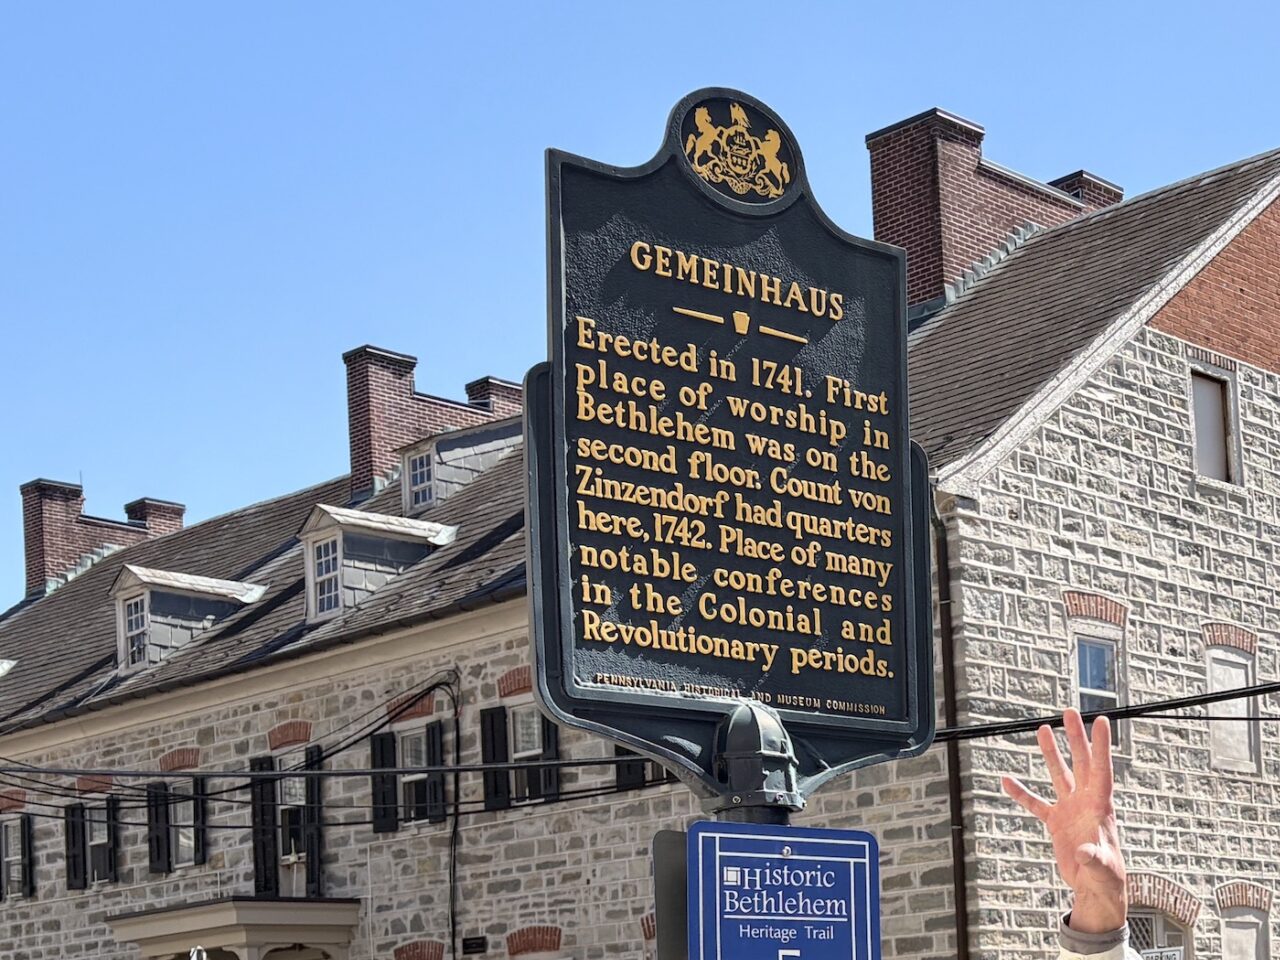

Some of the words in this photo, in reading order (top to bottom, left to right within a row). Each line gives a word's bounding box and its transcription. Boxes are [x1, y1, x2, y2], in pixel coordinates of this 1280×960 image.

[630, 241, 844, 321] GEMEINHAUS
[576, 316, 698, 373] Erected
[709, 350, 737, 382] in
[752, 357, 812, 399] 1741.
[825, 375, 890, 416] First
[575, 359, 666, 401] place
[679, 382, 713, 411] of
[726, 395, 847, 447] worship
[863, 419, 890, 450] in
[576, 391, 736, 450] Bethlehem
[745, 433, 796, 463] was
[806, 447, 838, 473] on
[849, 451, 891, 483] the
[575, 465, 730, 519] Zinzendorf
[735, 493, 782, 528] had
[786, 510, 893, 548] quarters
[577, 437, 678, 474] second
[688, 452, 762, 491] floor.
[770, 467, 843, 506] Count
[848, 489, 892, 515] von
[578, 501, 649, 543] here,
[652, 513, 713, 549] 1742.
[719, 525, 786, 563] Place
[790, 542, 823, 568] of
[825, 551, 894, 587] many
[580, 545, 697, 582] notable
[713, 567, 893, 612] conferences
[581, 574, 612, 607] in
[630, 582, 683, 616] the
[699, 592, 823, 637] Colonial
[840, 619, 893, 646] and
[582, 609, 779, 671] Revolutionary
[790, 646, 895, 679] periods.
[596, 672, 677, 692] PENNSYLVANIA
[684, 683, 740, 697] HISTORICAL
[751, 690, 772, 703] AND
[777, 694, 820, 708] MUSEUM
[826, 699, 886, 715] COMMISSION
[723, 890, 847, 916] Bethlehem
[743, 862, 835, 891] Historic
[739, 924, 797, 943] Heritage
[804, 925, 834, 940] Trail
